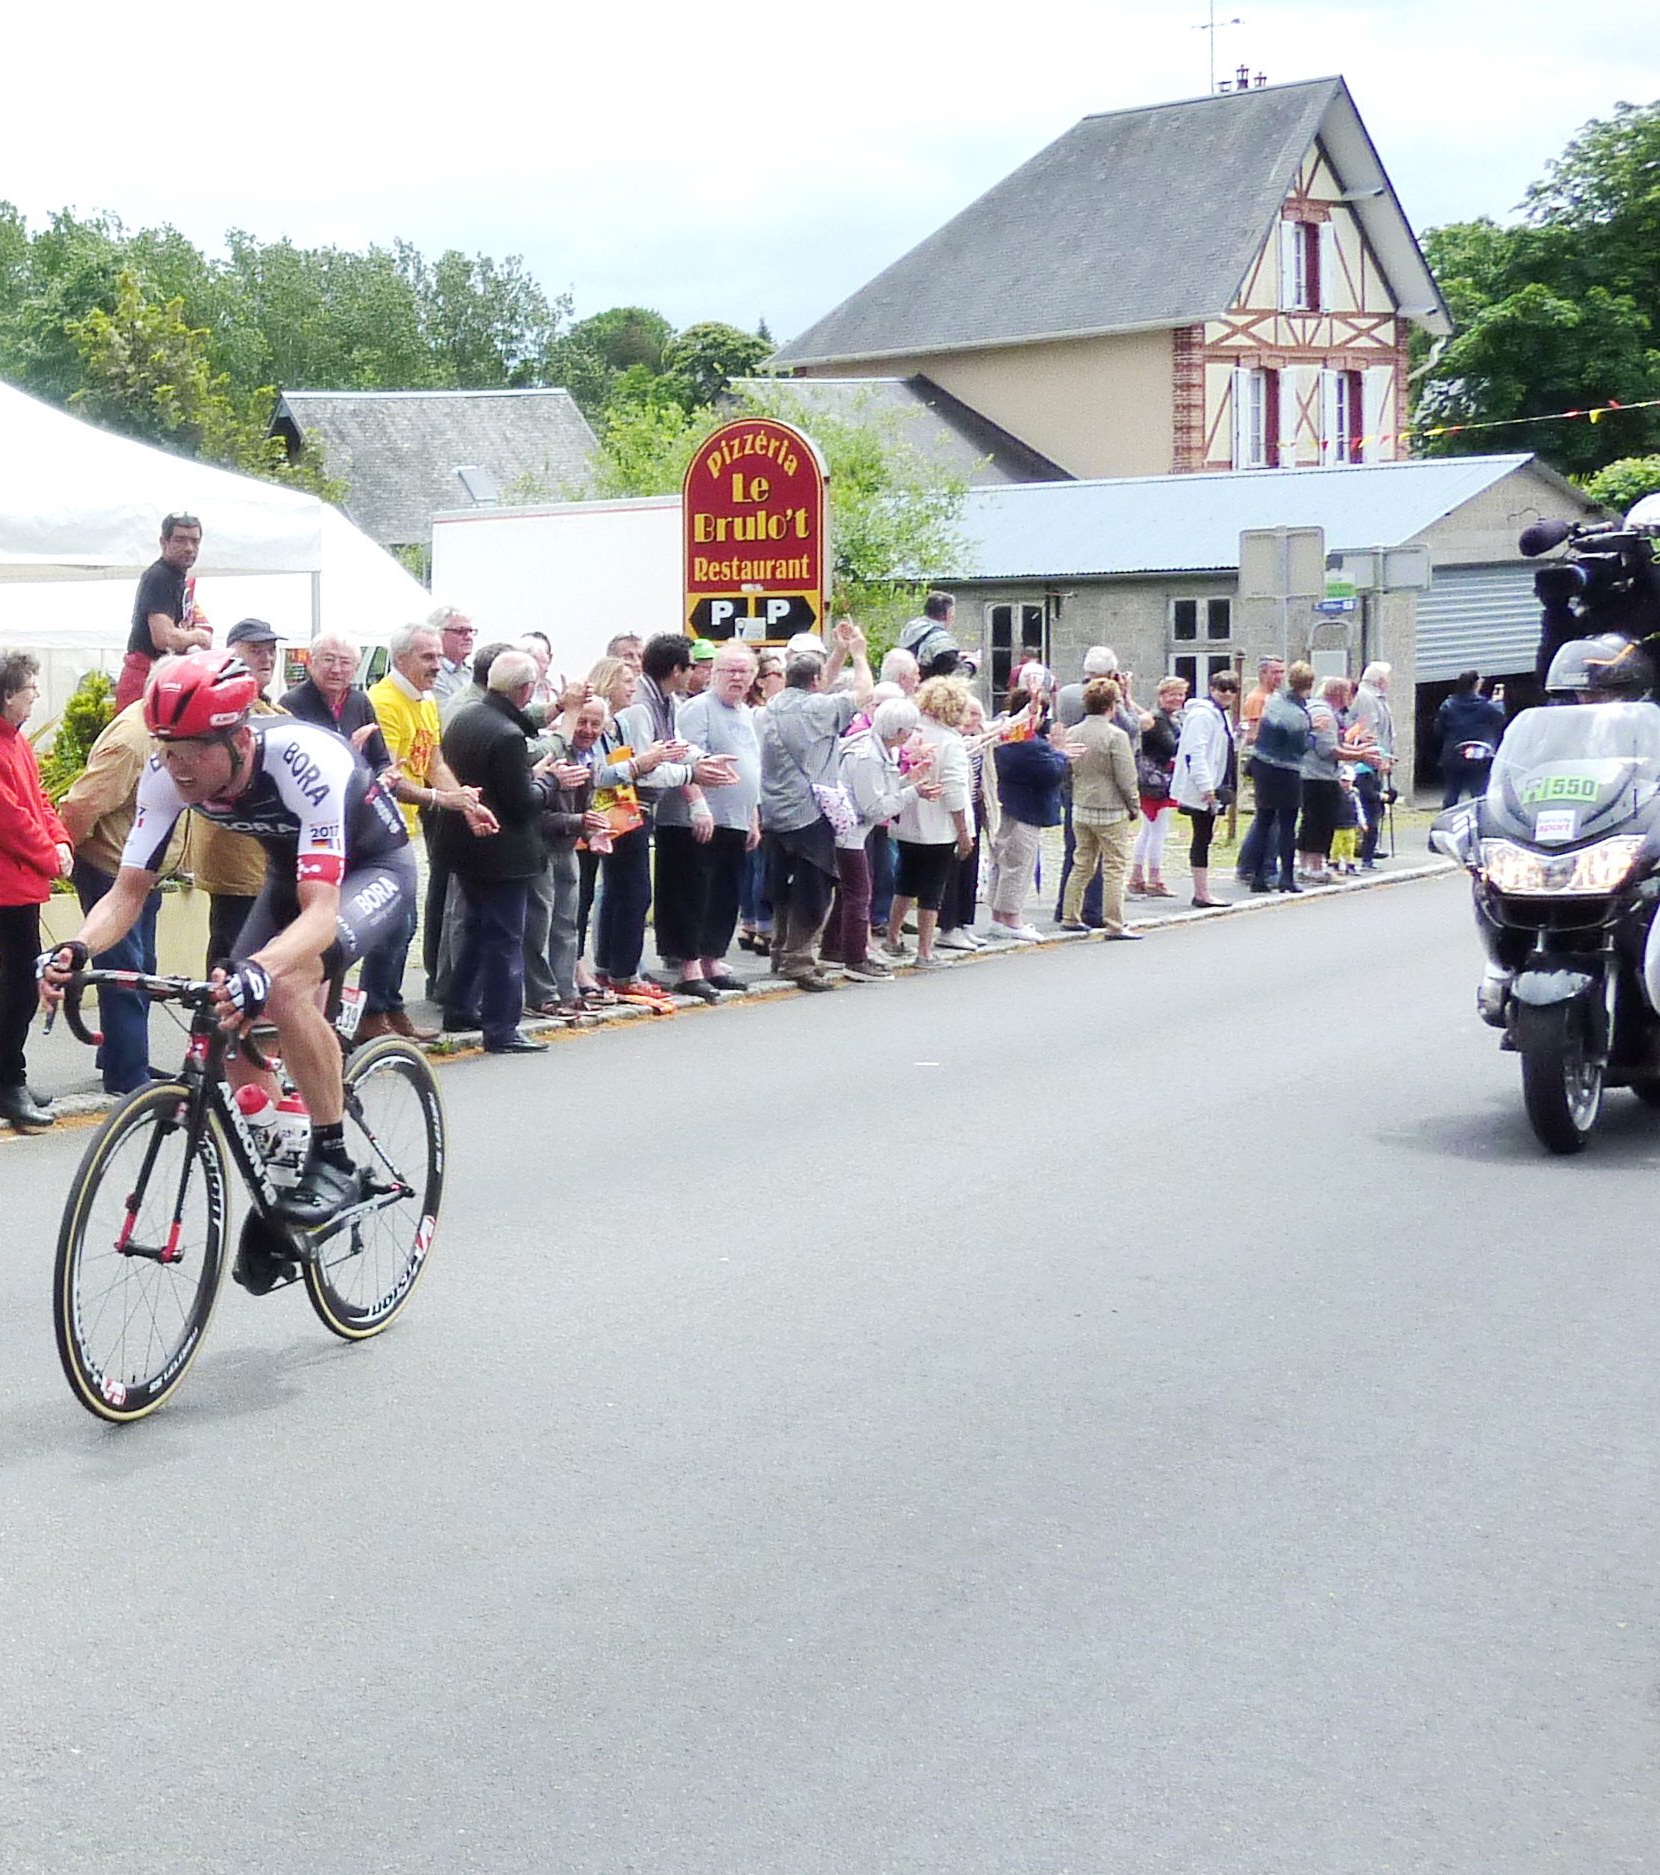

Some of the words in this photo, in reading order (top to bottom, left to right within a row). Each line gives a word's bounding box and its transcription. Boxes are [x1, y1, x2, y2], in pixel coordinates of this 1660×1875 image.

[706, 430, 798, 479] Pizzéria
[732, 473, 770, 503] Le
[693, 508, 810, 543] Brulo't
[693, 554, 810, 582] Restaurant
[711, 601, 734, 625] P
[767, 600, 790, 624] P
[283, 741, 331, 807] BORA
[1551, 778, 1596, 796] 550
[309, 825, 340, 838] 2017
[354, 876, 400, 916] BORA
[217, 1081, 268, 1178] ARGON
